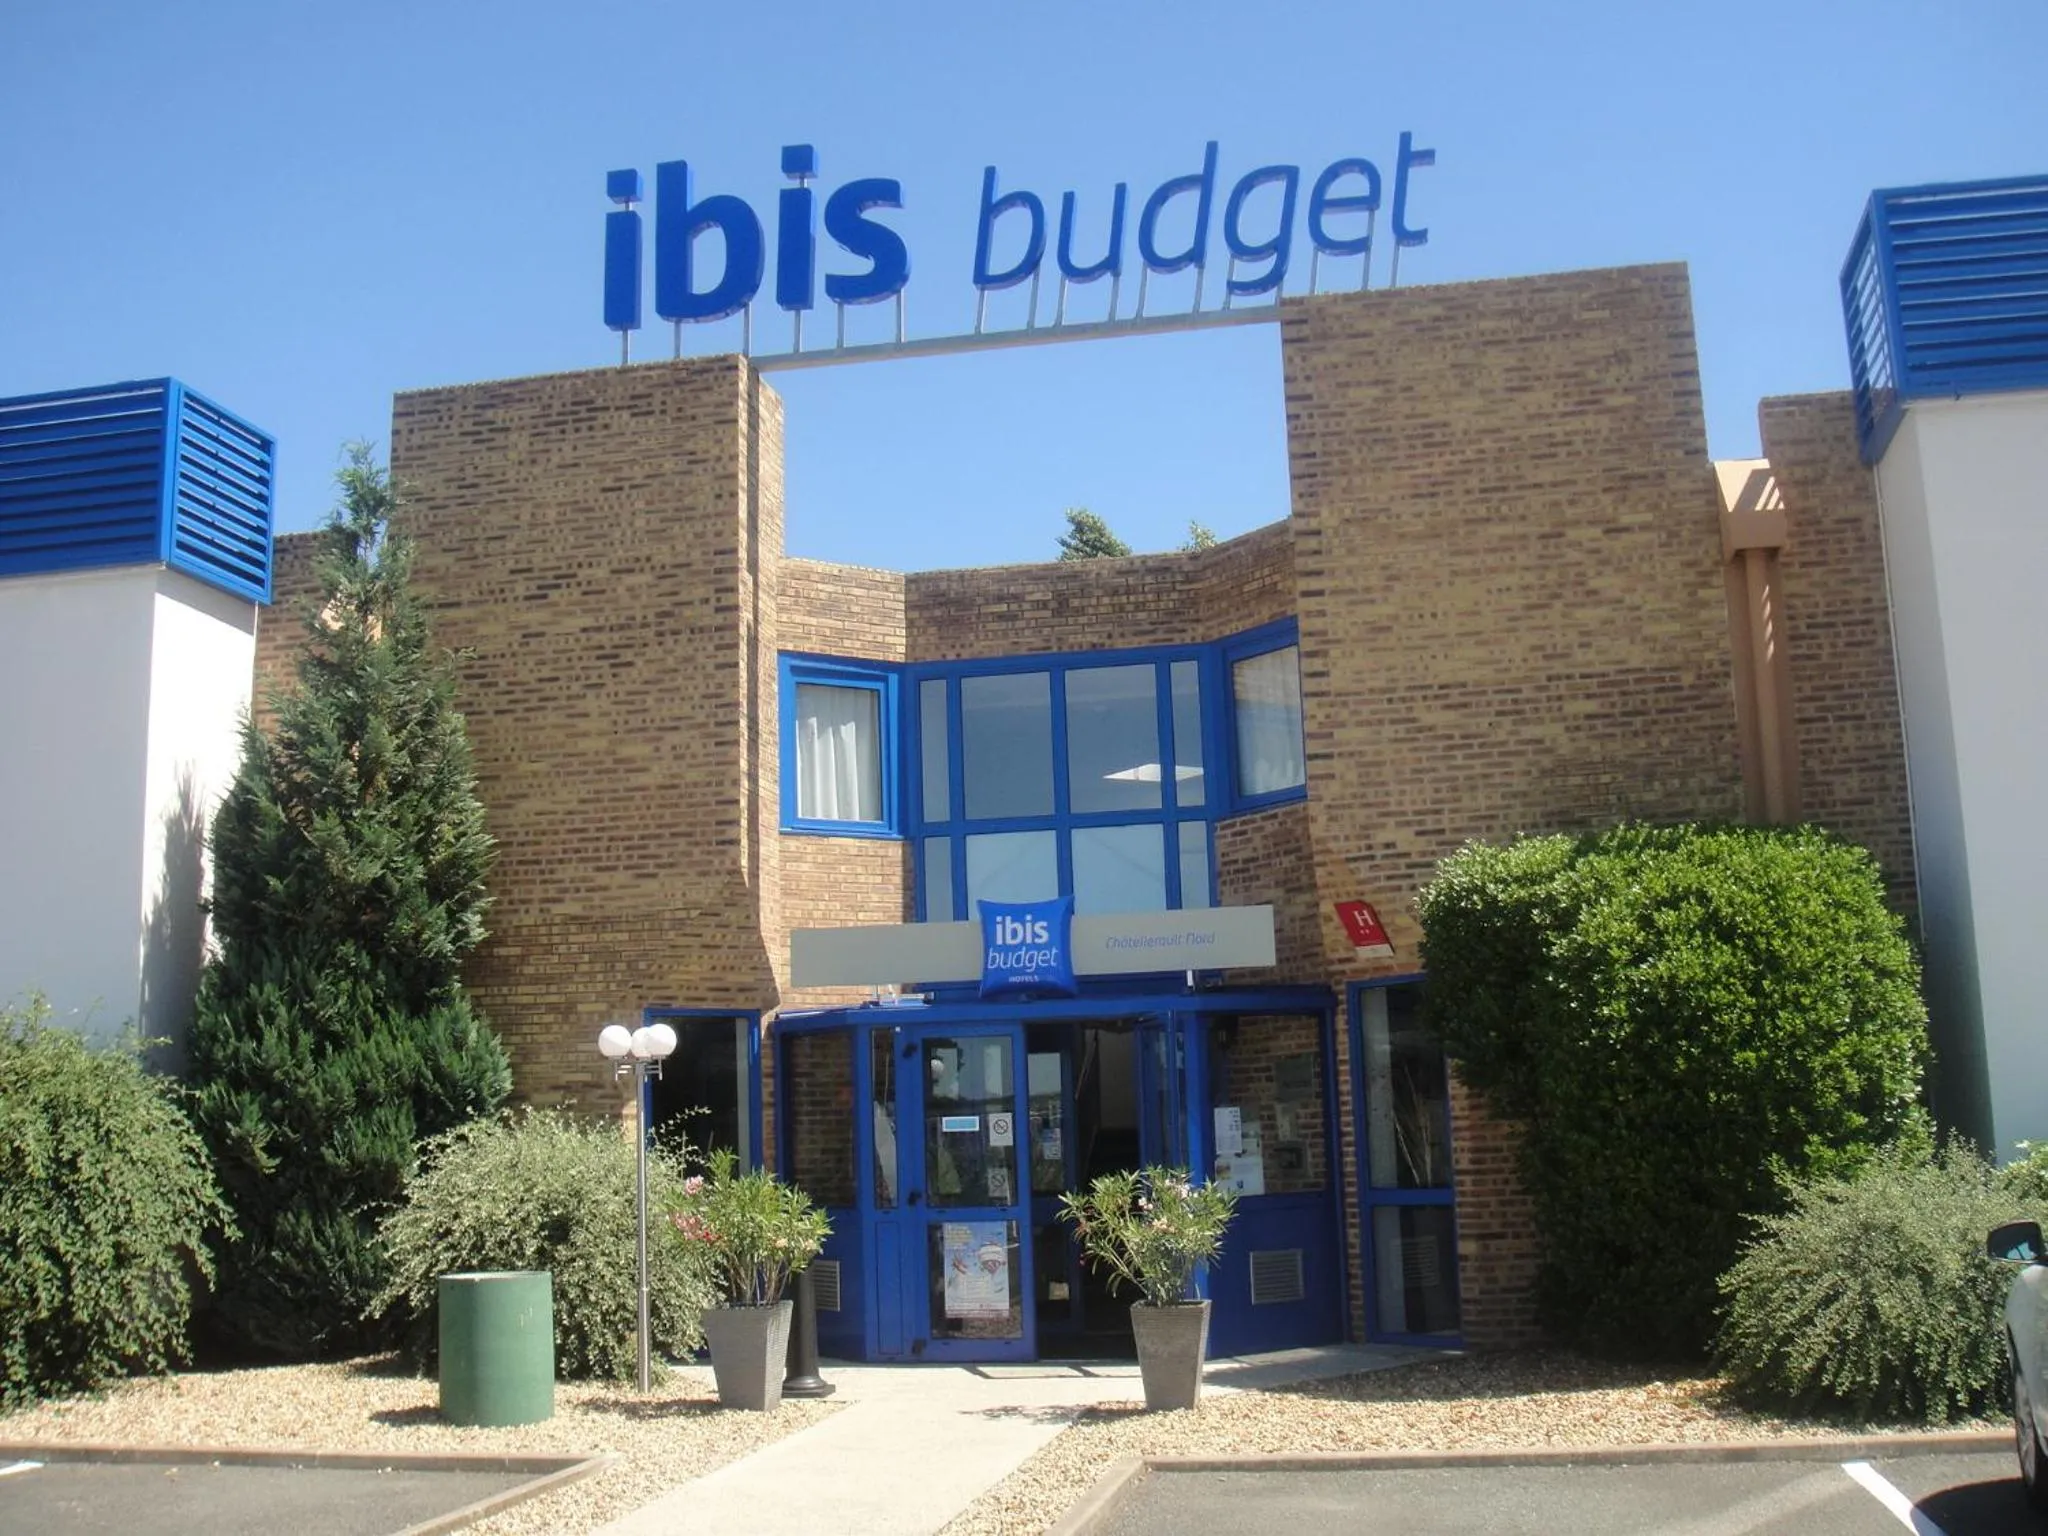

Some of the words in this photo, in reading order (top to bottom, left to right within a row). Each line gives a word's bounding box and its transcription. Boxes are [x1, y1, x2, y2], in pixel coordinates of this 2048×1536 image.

[603, 144, 912, 332] ibis
[972, 130, 1437, 297] budget
[996, 914, 1049, 945] ibis
[1353, 909, 1374, 927] H
[987, 946, 1059, 972] budget
